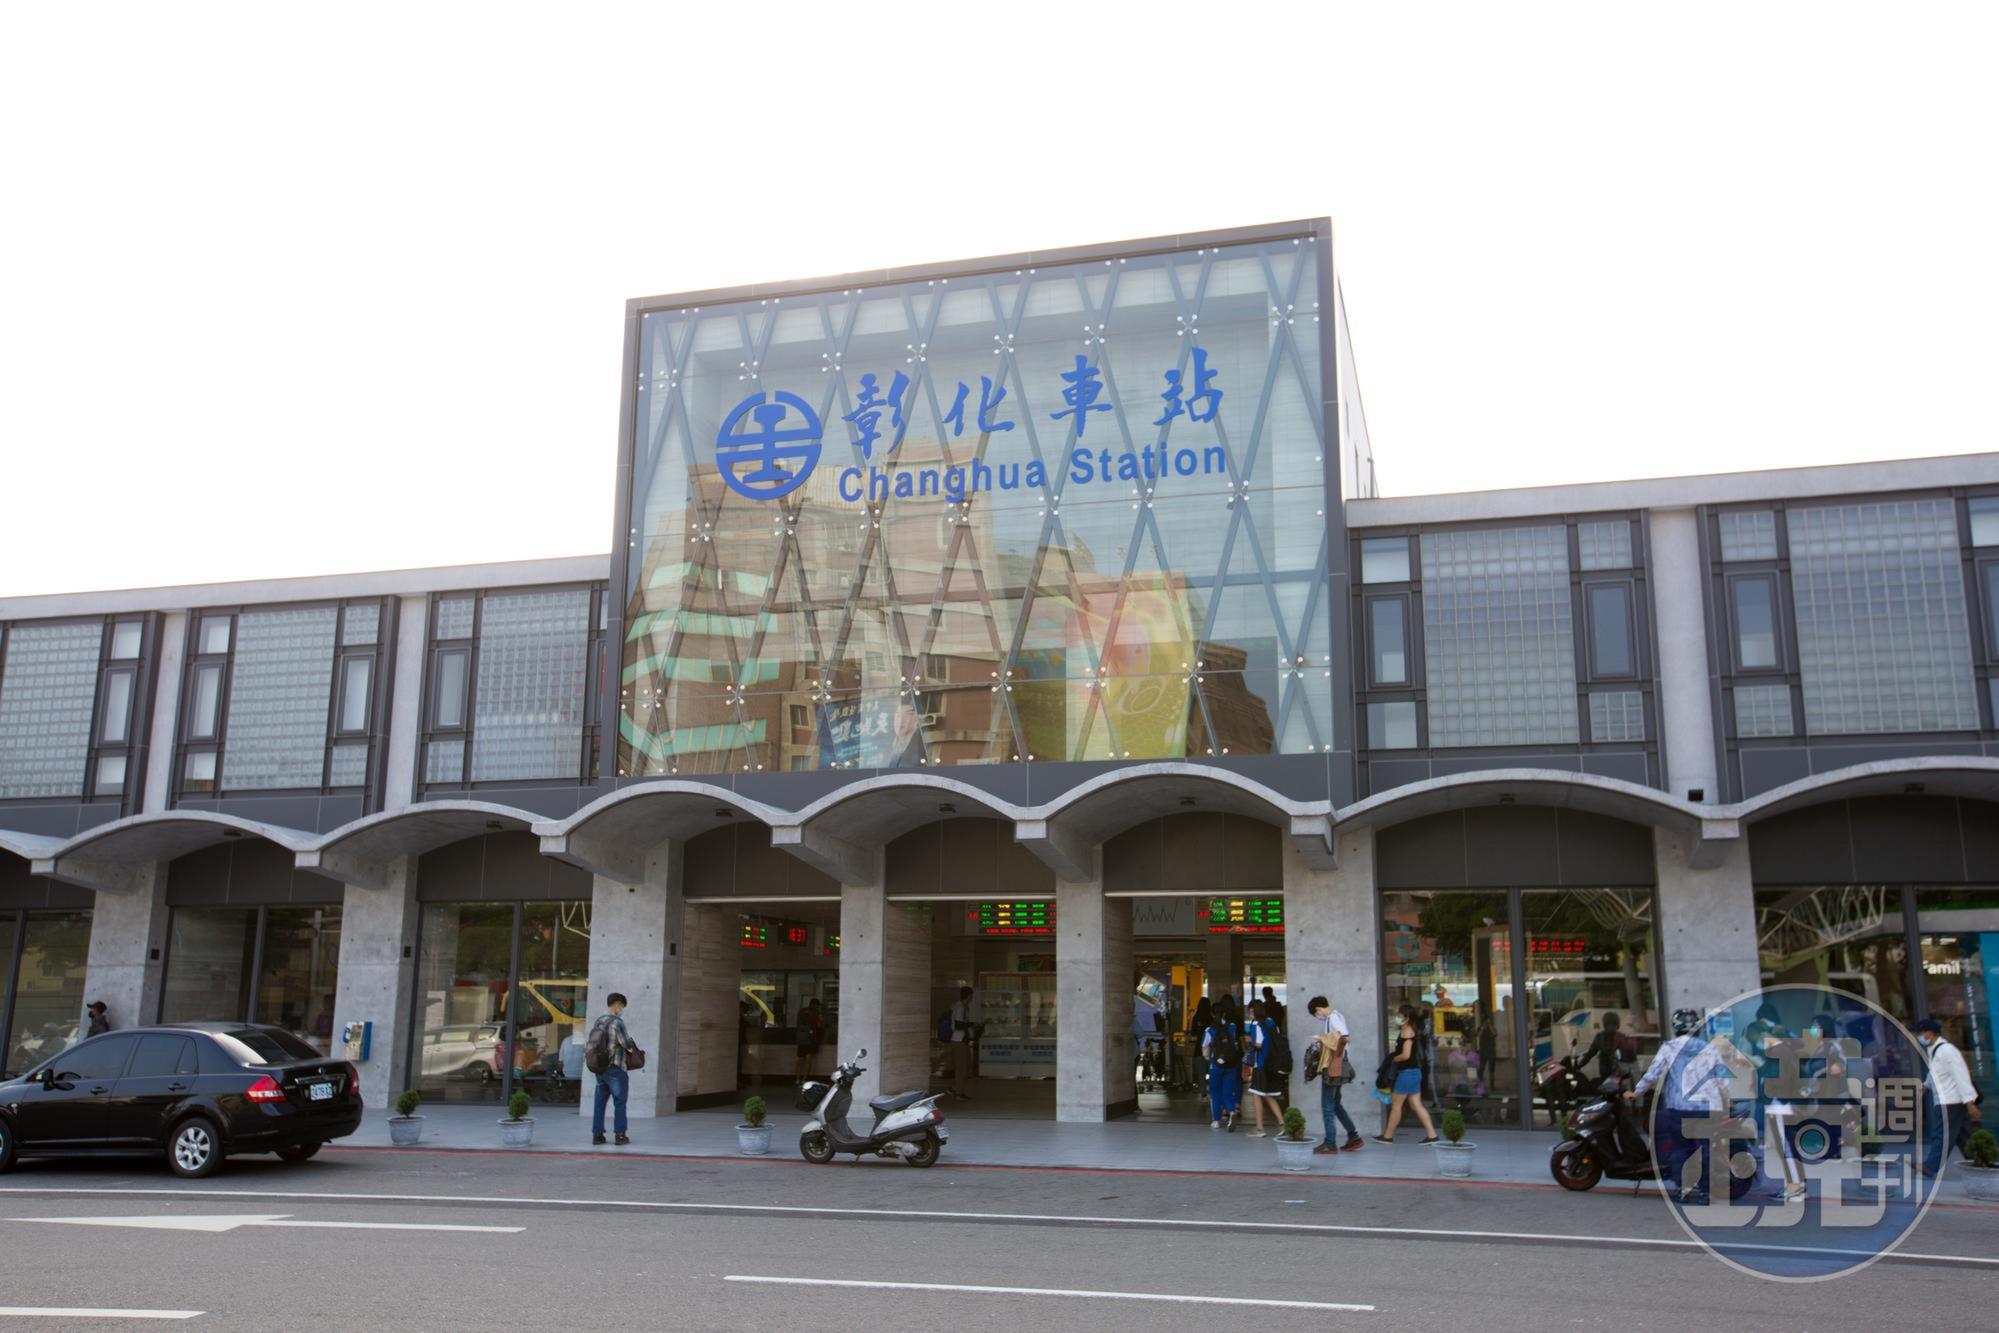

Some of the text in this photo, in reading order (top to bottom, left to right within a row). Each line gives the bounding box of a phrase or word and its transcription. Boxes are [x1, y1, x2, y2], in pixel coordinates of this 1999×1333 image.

[842, 346, 1224, 458] 彰化車站
[838, 440, 1226, 502] Changhua Station
